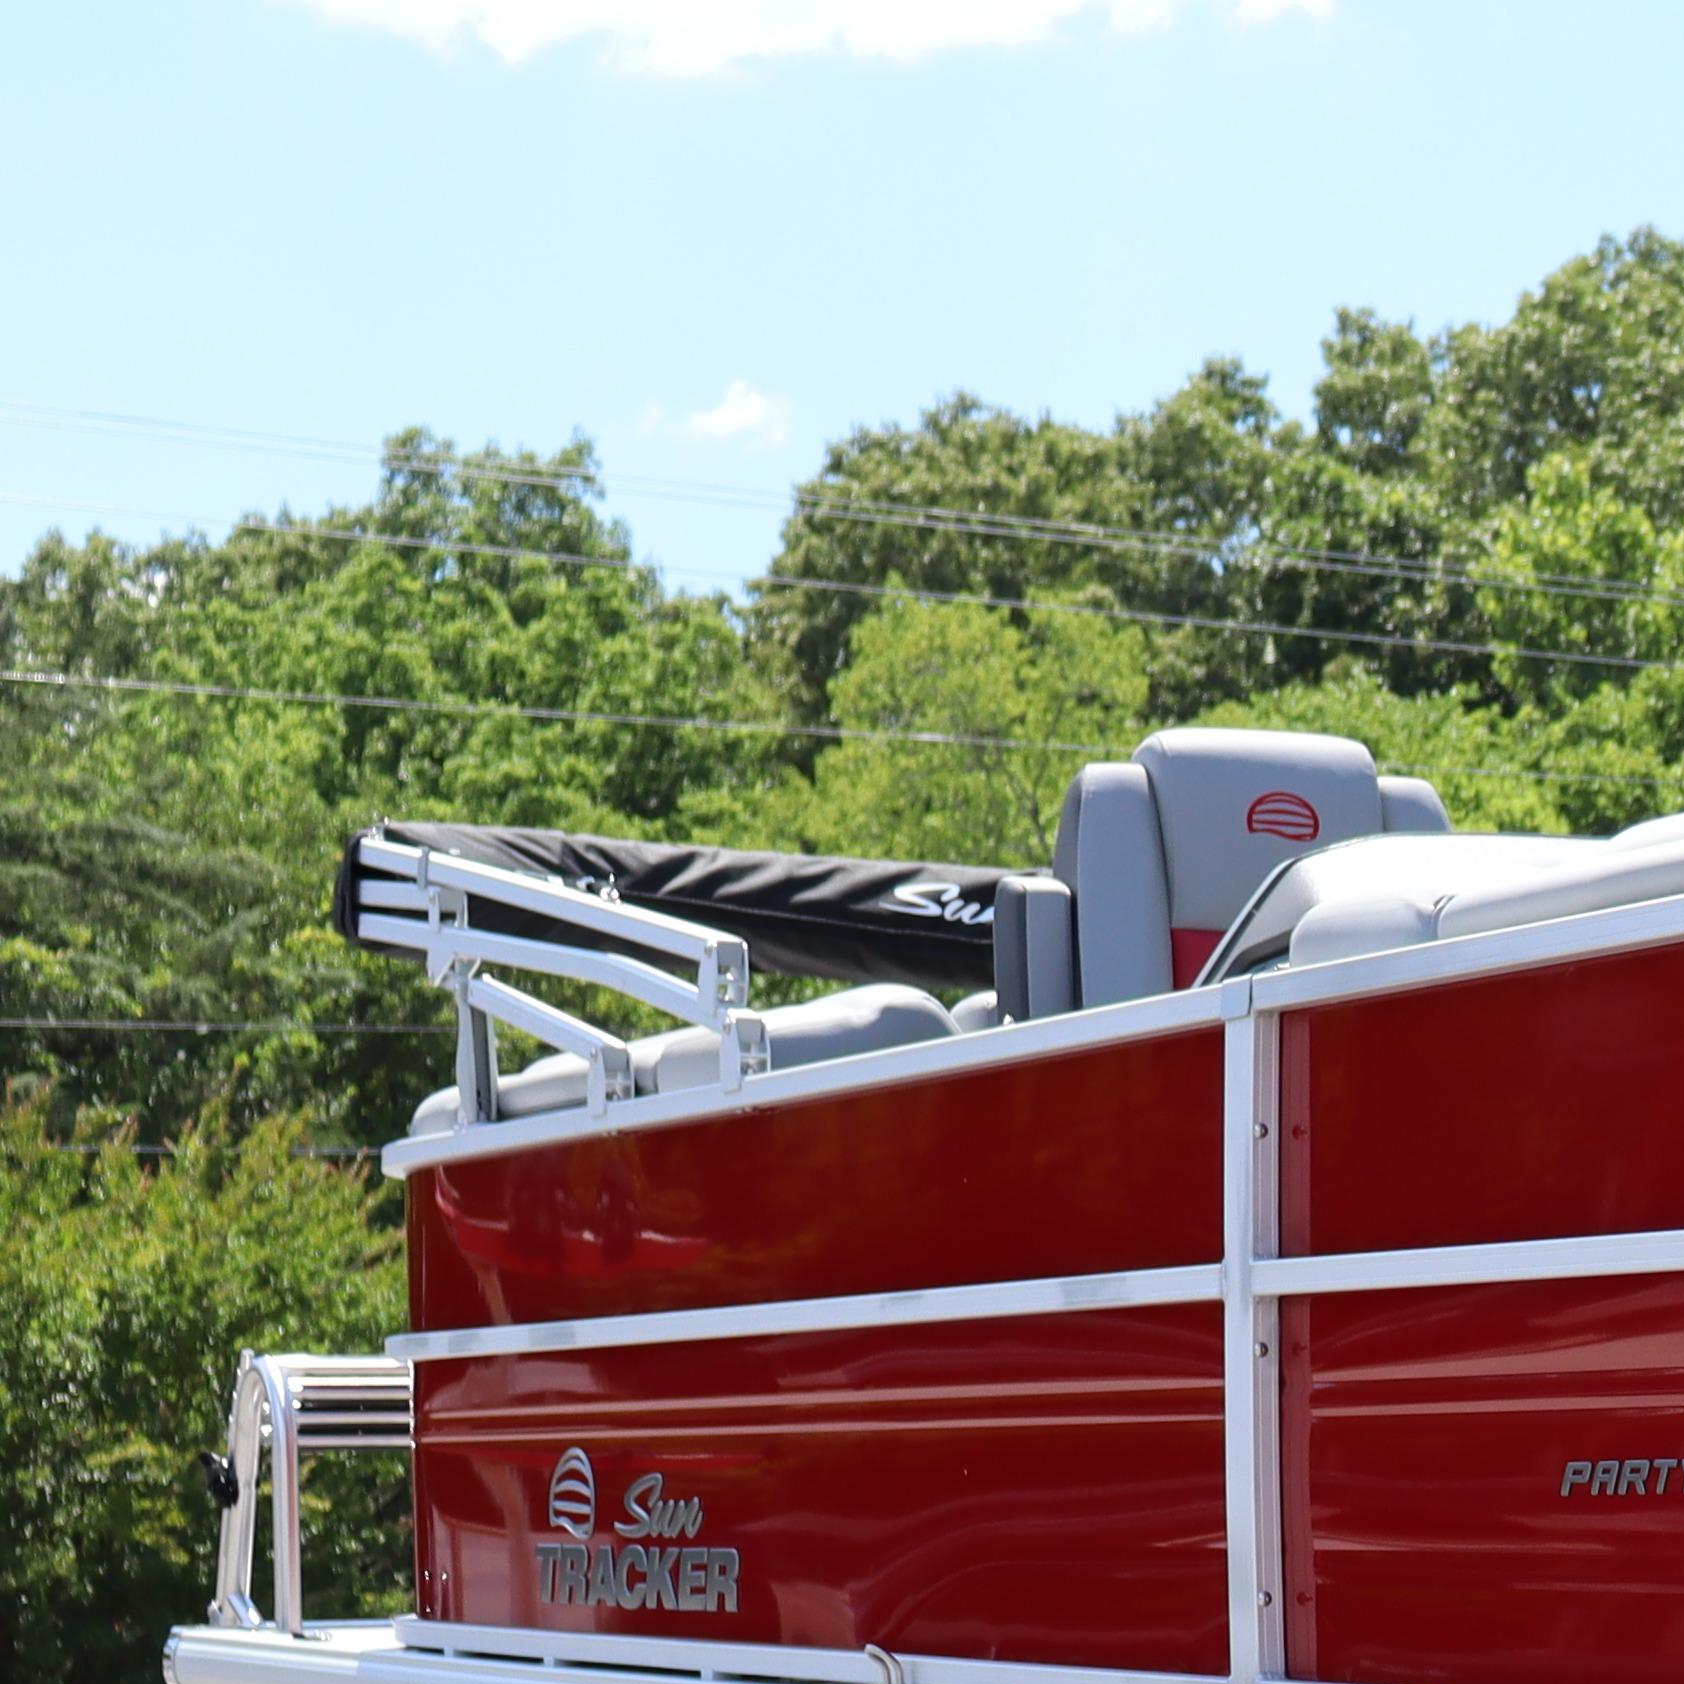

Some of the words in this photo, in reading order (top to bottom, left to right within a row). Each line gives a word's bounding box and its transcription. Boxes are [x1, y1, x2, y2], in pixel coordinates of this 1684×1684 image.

[879, 883, 995, 924] Su
[614, 1472, 703, 1538] Sun
[536, 1543, 740, 1612] TRACKER
